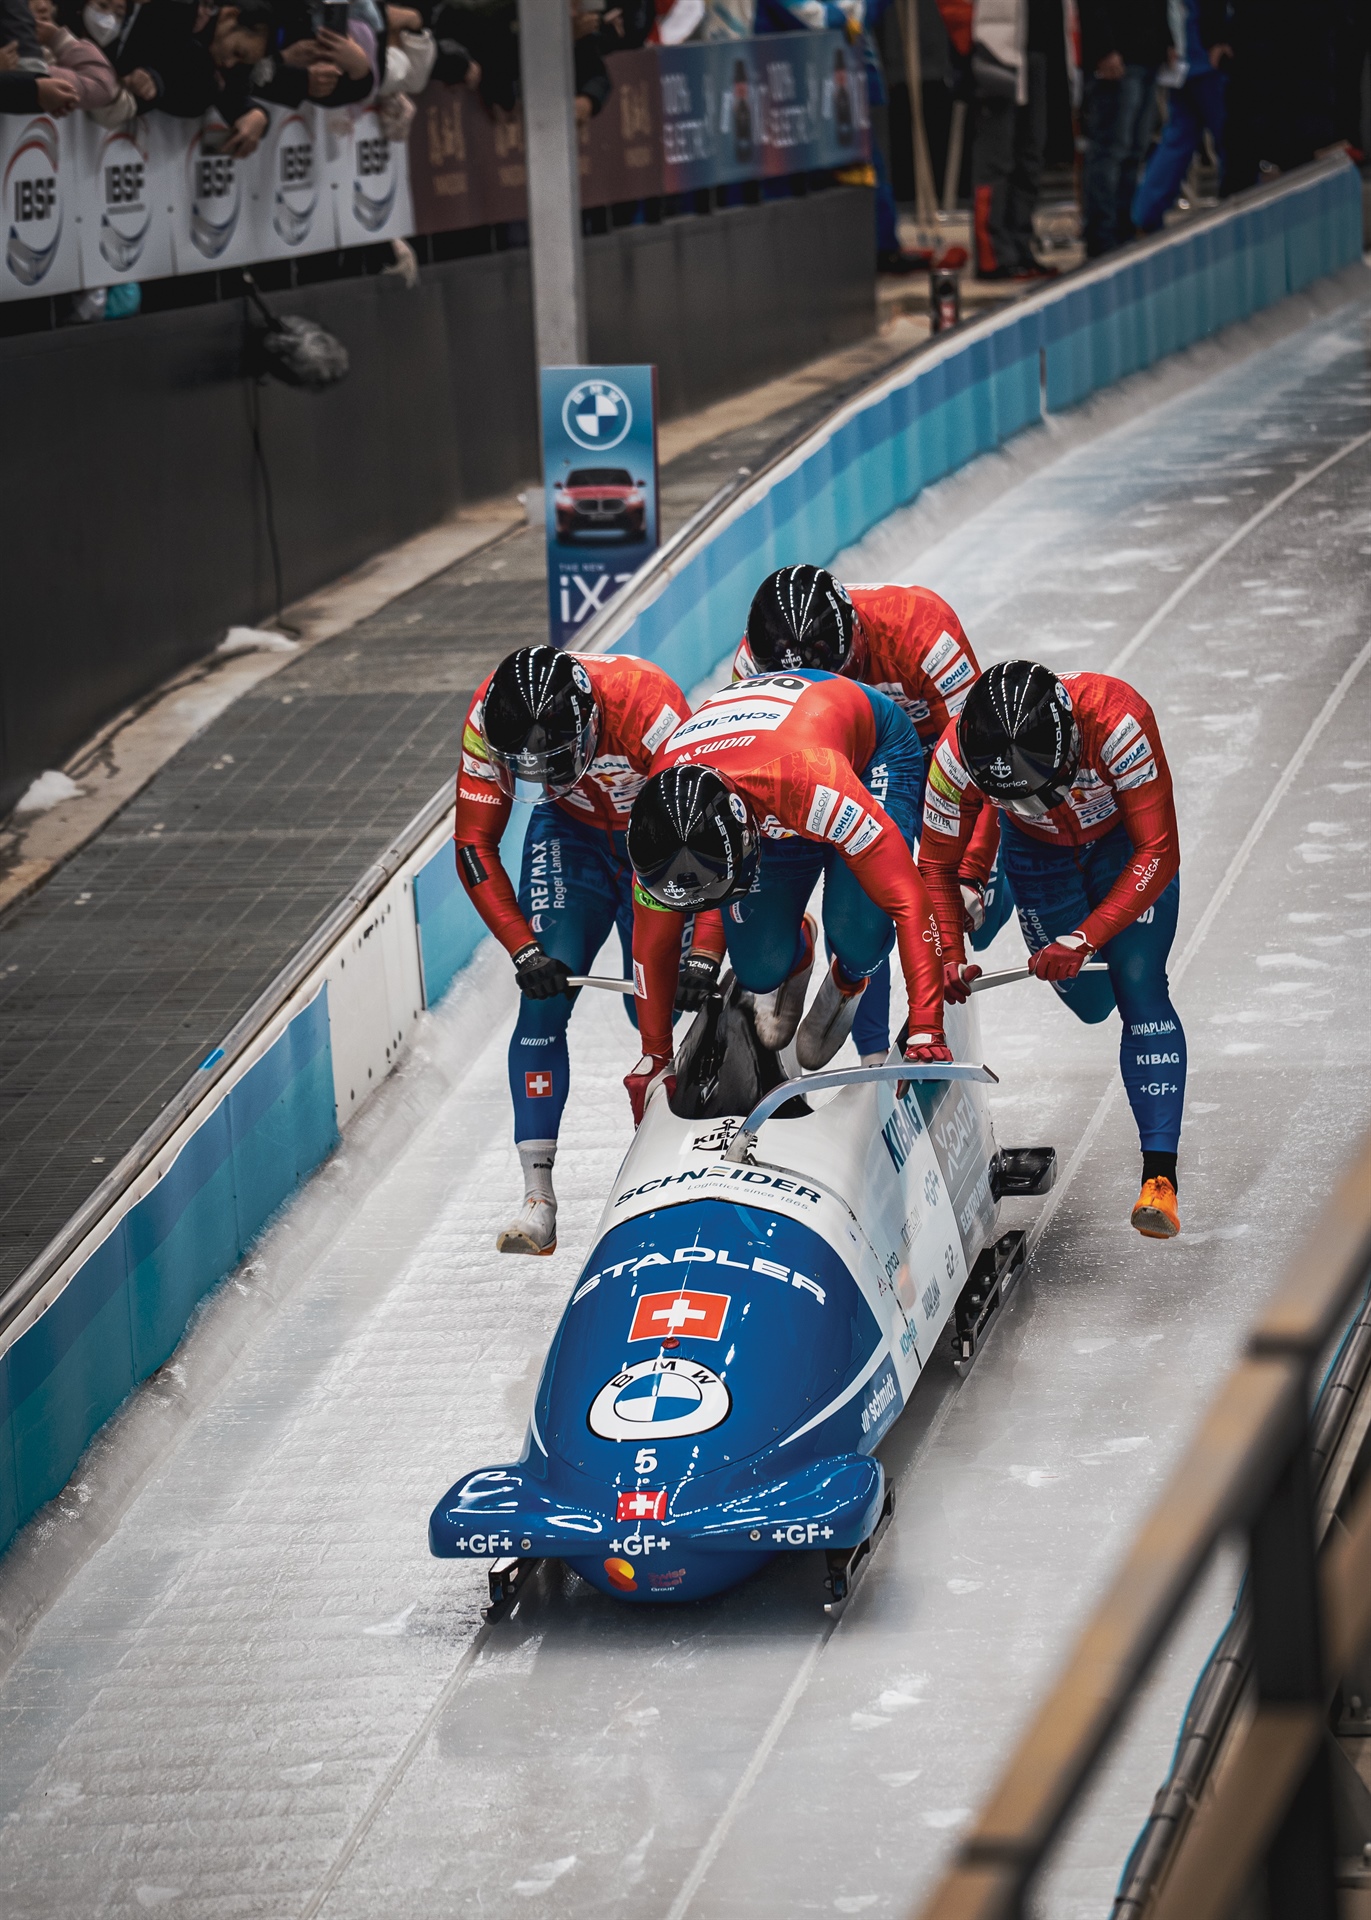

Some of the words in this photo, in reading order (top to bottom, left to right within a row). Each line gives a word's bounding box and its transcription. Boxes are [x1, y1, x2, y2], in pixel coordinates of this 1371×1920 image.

[280, 143, 313, 182] IBSF
[356, 137, 391, 176] IBSF
[104, 163, 145, 204] IBSF
[198, 156, 235, 198] IBSF
[14, 177, 57, 222] IBSF
[825, 590, 845, 654] STADLER
[940, 661, 969, 690] KOHLER
[570, 694, 582, 759] STADLER
[673, 711, 781, 740] SCHNEIDER
[1049, 701, 1062, 768] STADLER
[1114, 742, 1146, 774] KOHLER
[459, 787, 503, 805] makita
[996, 779, 1028, 790] aprico
[831, 804, 855, 839] KOHLER
[550, 838, 562, 874] Landolt
[714, 815, 734, 880] STADLER
[530, 840, 550, 911] RE/MAX
[553, 876, 568, 909] Roger
[1135, 857, 1161, 892] OMEGA
[928, 913, 943, 957] OMEGA
[515, 946, 540, 965] HIRZL
[687, 960, 714, 973] HIRZL
[1130, 1019, 1177, 1036] SILVAPLANA
[1136, 1052, 1180, 1065] KIBAG
[881, 1092, 923, 1175] KIBAG
[614, 1165, 822, 1208] SCHNEIDER
[687, 1180, 741, 1191] Logistics
[743, 1188, 775, 1199] since
[571, 1246, 828, 1306] STADLER
[610, 1360, 717, 1389] BMW
[868, 1372, 897, 1422] schmidt
[634, 1447, 658, 1474] 5
